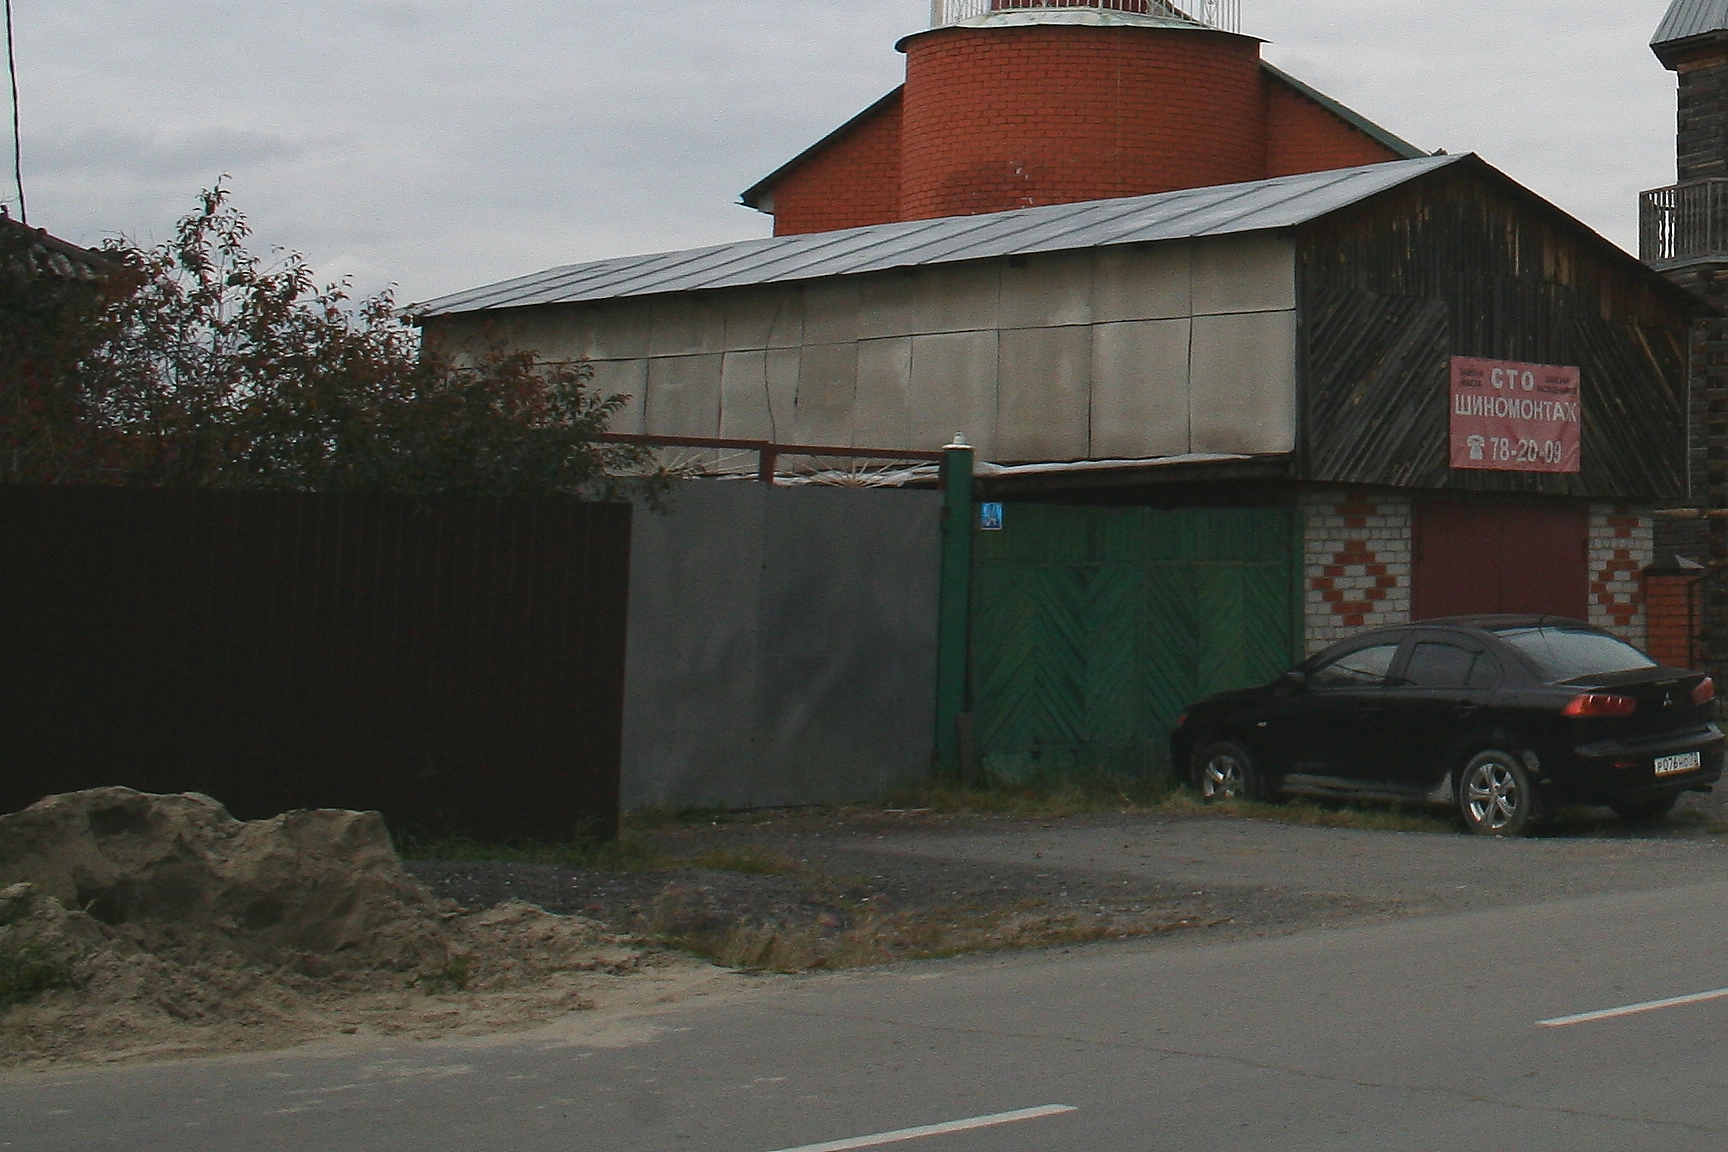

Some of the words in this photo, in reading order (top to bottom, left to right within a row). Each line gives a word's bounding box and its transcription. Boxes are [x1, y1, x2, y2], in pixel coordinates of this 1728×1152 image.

[1491, 368, 1534, 391] СТО
[1455, 394, 1577, 422] ШИНОМОНТАЖ
[1490, 437, 1562, 463] 78-20-09
